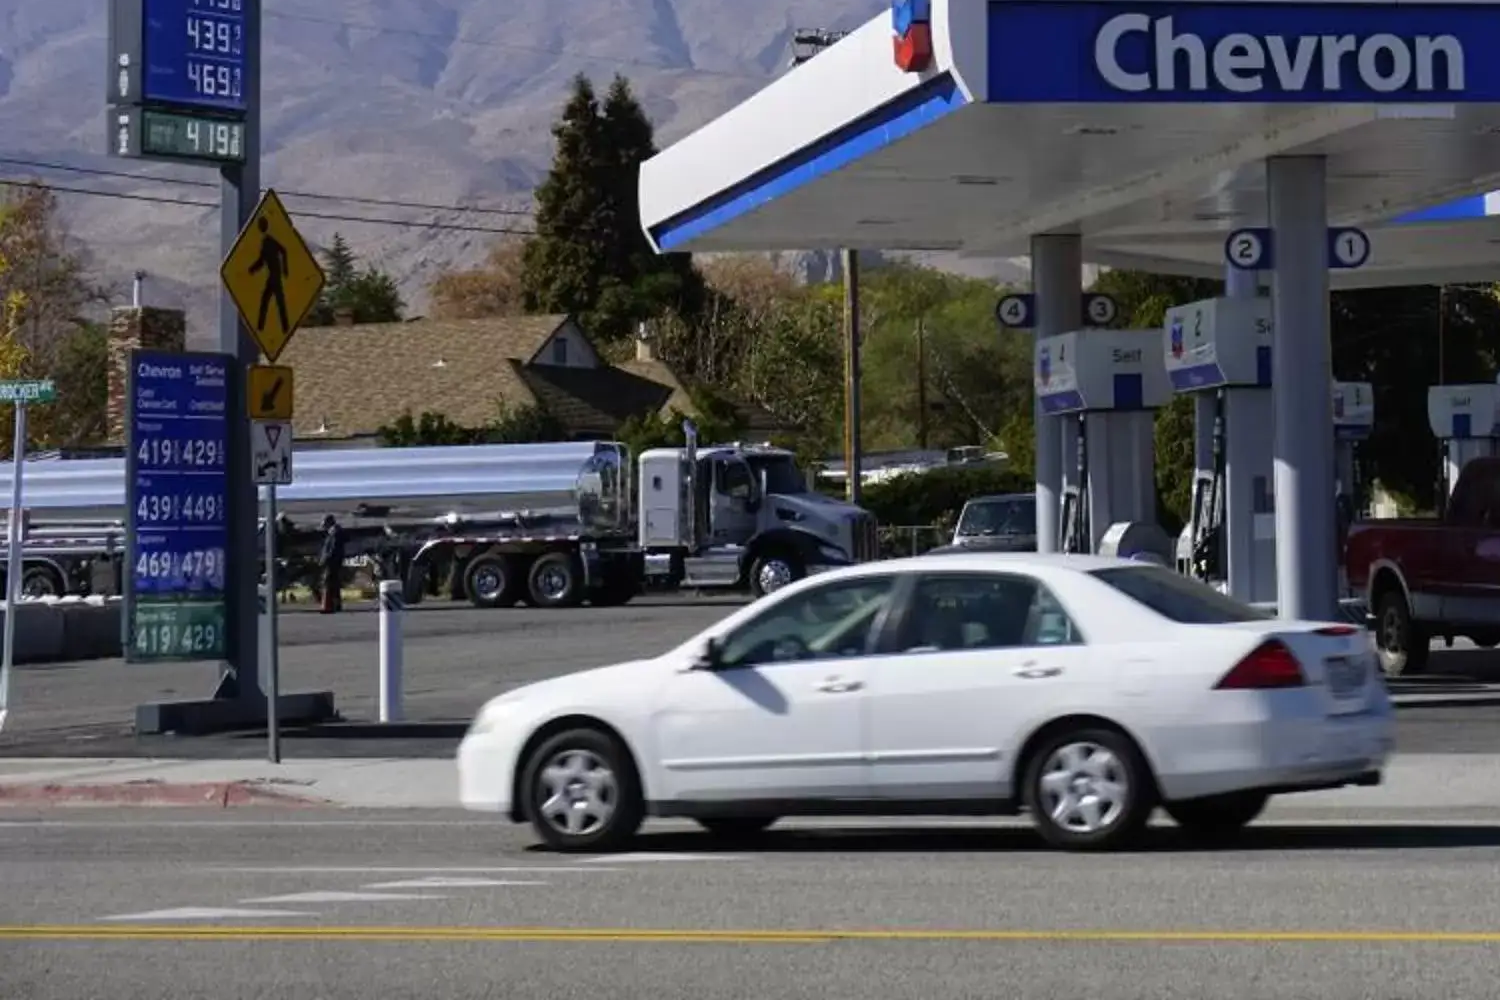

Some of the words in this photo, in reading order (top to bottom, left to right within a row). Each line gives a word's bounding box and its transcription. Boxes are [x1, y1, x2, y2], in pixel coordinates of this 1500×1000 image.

[1095, 12, 1465, 93] Chevron
[1238, 239, 1253, 259] 2
[1006, 302, 1020, 318] 4
[1095, 301, 1108, 318] 3
